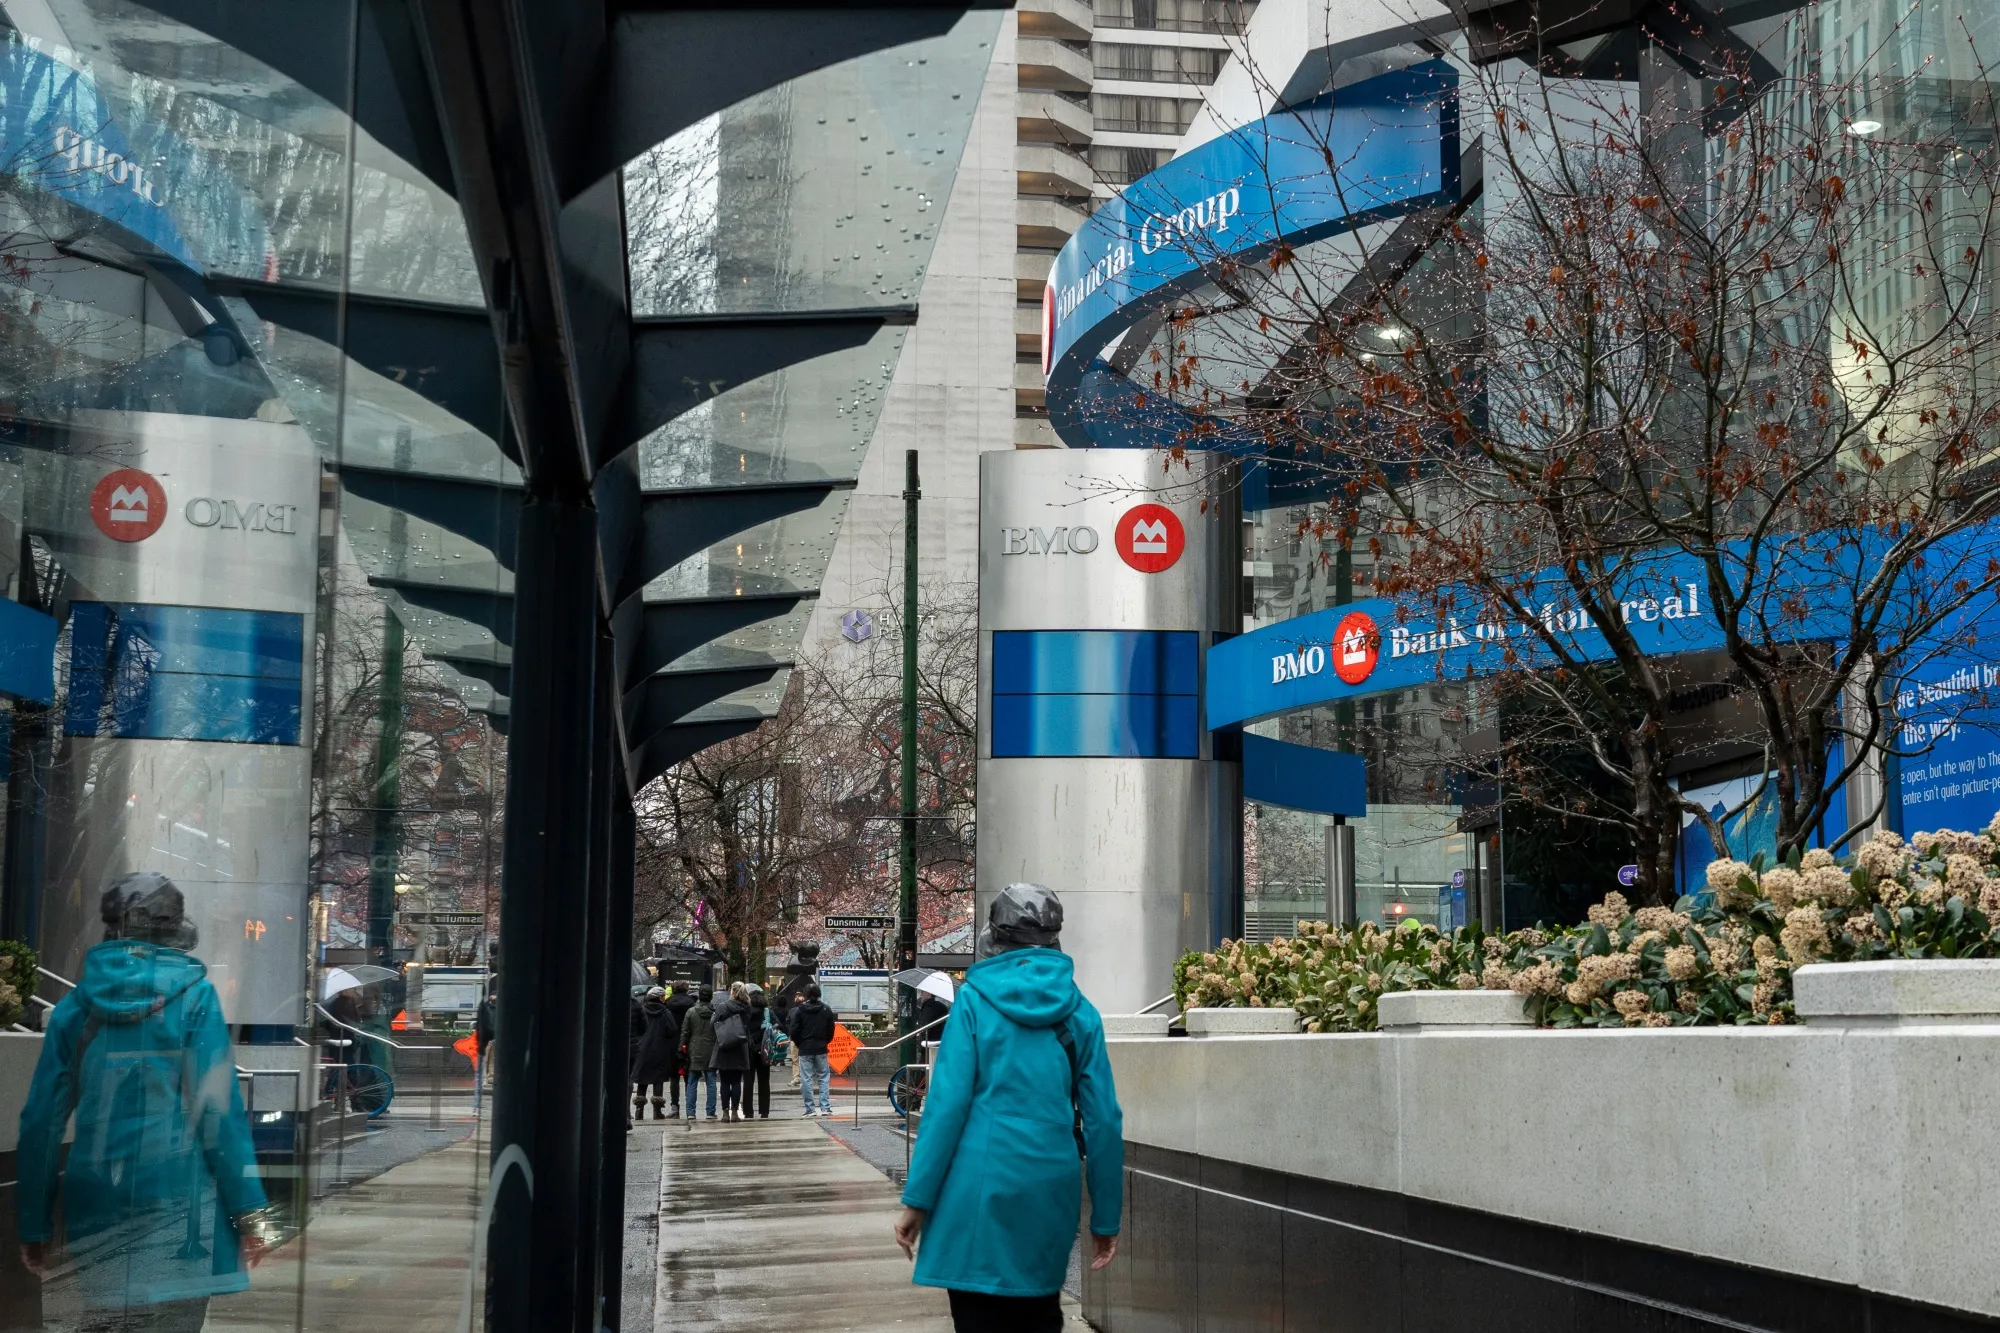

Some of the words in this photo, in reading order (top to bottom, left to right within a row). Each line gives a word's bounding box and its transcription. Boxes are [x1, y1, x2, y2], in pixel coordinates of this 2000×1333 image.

[1056, 228, 1135, 329] Financial
[1140, 188, 1240, 255] Group
[1001, 525, 1099, 556] BMO
[880, 613, 936, 627] HYTT
[1271, 646, 1325, 684] BMO
[1390, 617, 1470, 658] Bank
[1522, 583, 1702, 637] Monreal
[1918, 665, 1980, 705] beautiful
[1904, 720, 1926, 746] the
[1907, 769, 1928, 786] open,
[1929, 763, 1942, 779] but
[1944, 759, 1957, 776] the
[1958, 757, 1975, 774] way
[1977, 755, 1986, 769] to
[1902, 791, 1922, 806] entre
[1923, 784, 1939, 802] isn't
[1941, 782, 1960, 802] quite
[827, 918, 868, 927] Dunsmuir
